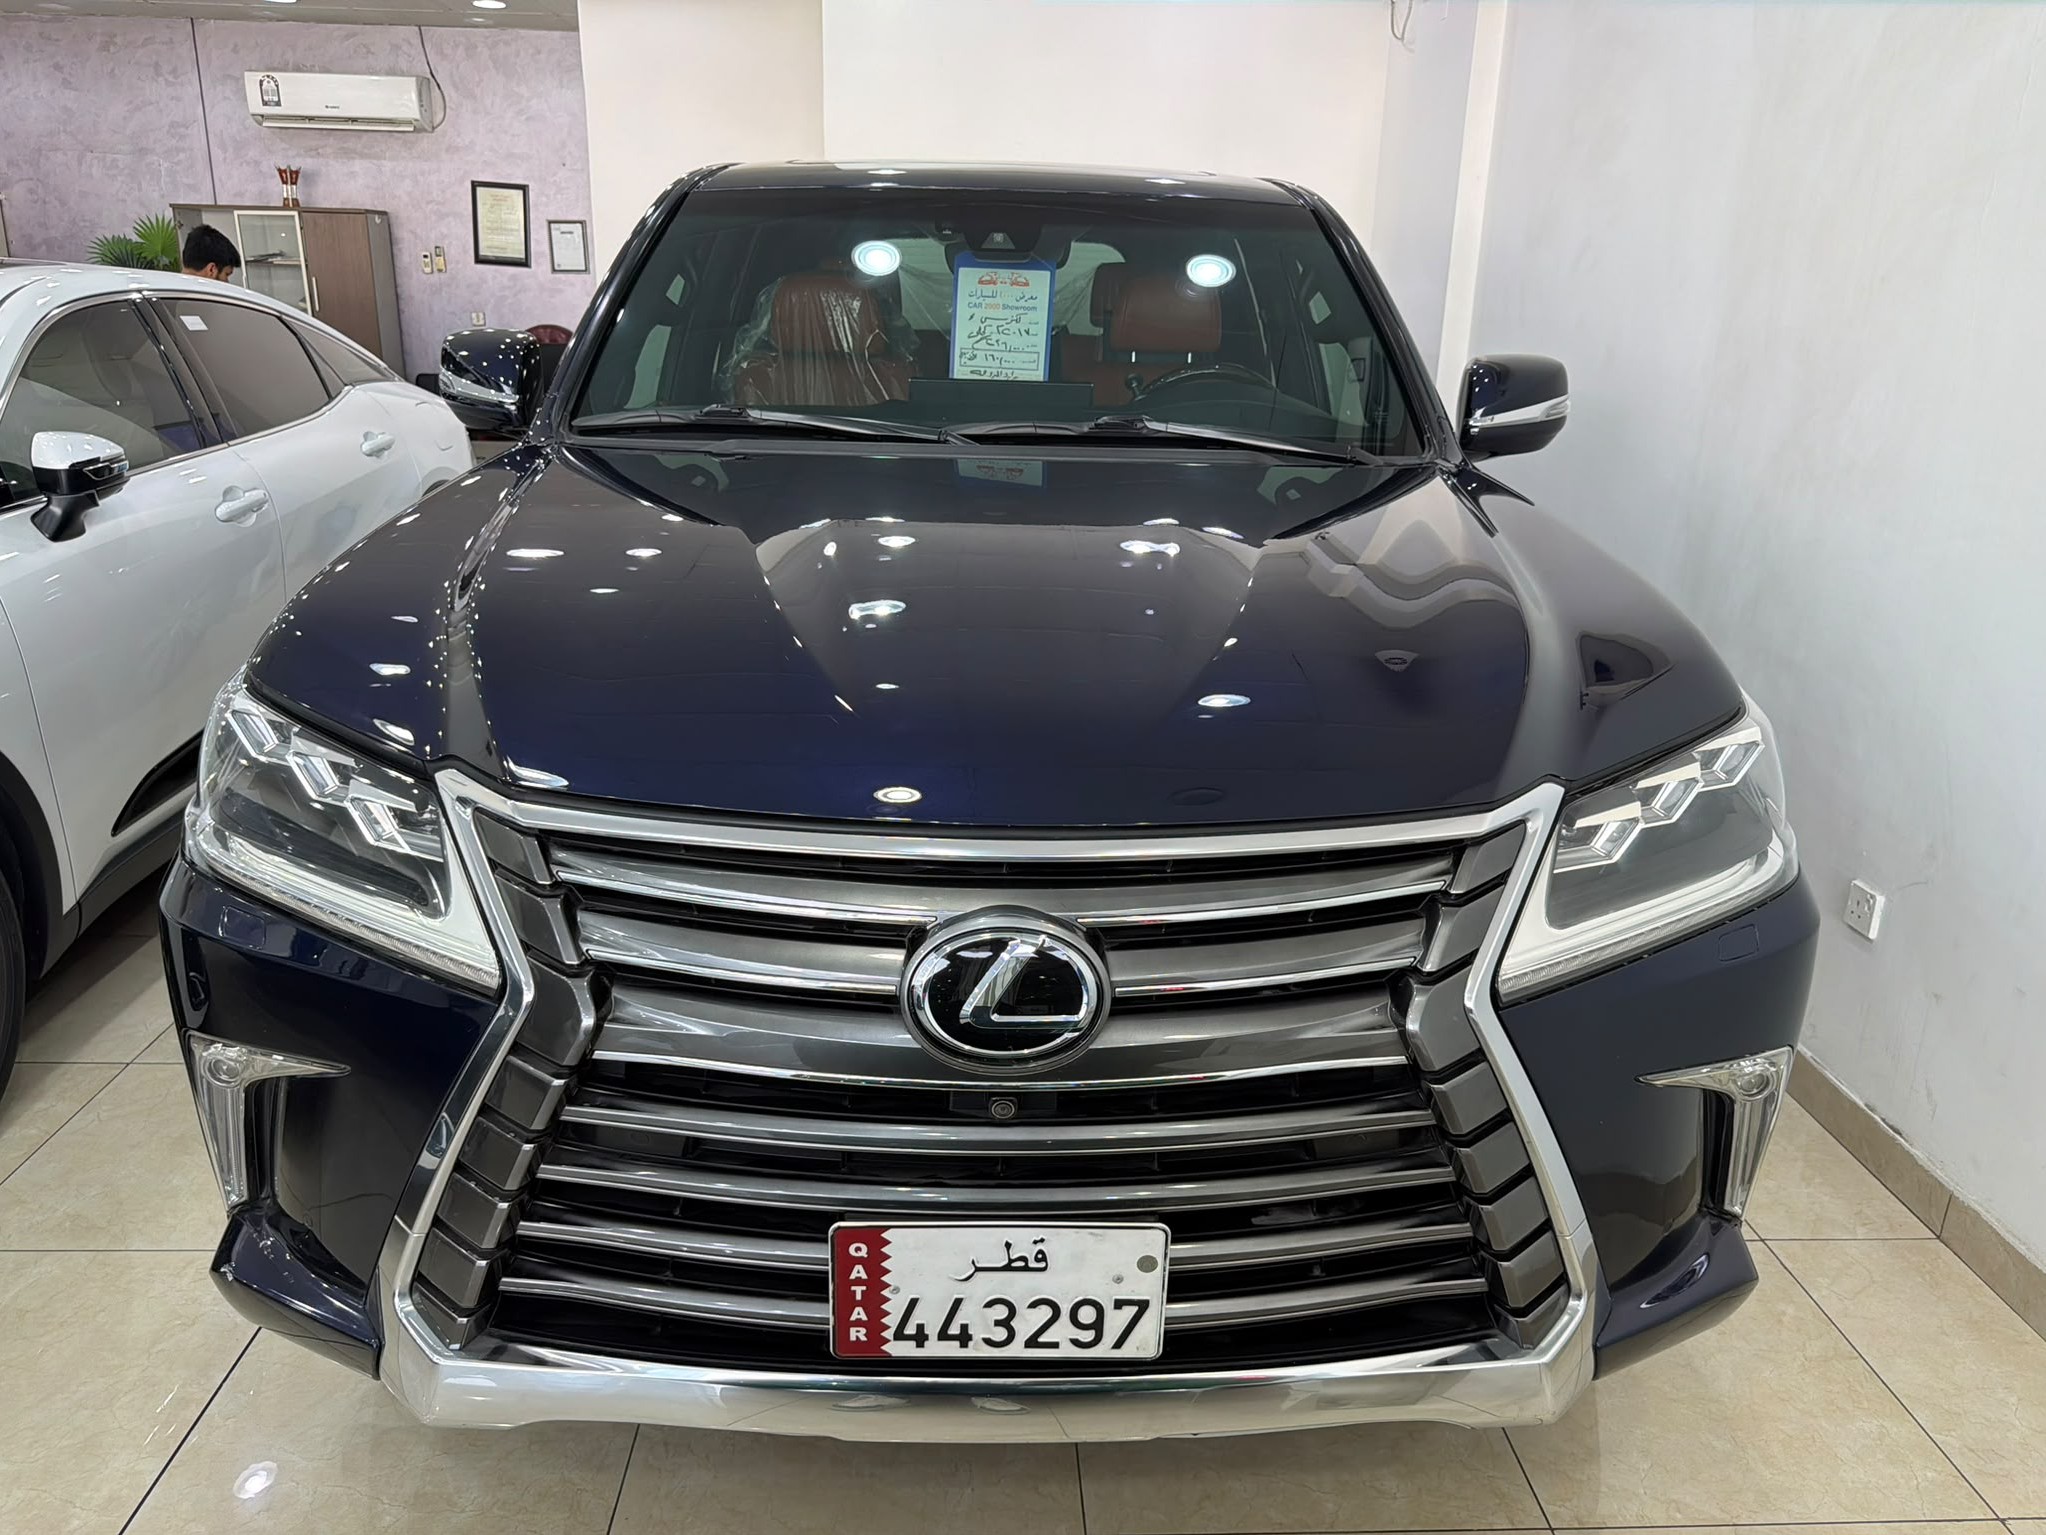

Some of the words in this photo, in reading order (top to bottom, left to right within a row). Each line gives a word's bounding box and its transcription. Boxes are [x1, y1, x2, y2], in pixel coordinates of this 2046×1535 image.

[967, 302, 983, 310] CAR
[984, 303, 1001, 311] 2000
[1001, 303, 1038, 313] Showroom
[968, 288, 998, 302] للسيارات
[1015, 292, 1038, 303] معرض
[951, 1236, 1049, 1283] قطر
[848, 1242, 869, 1342] QATAR
[892, 1296, 1151, 1351] 443297
